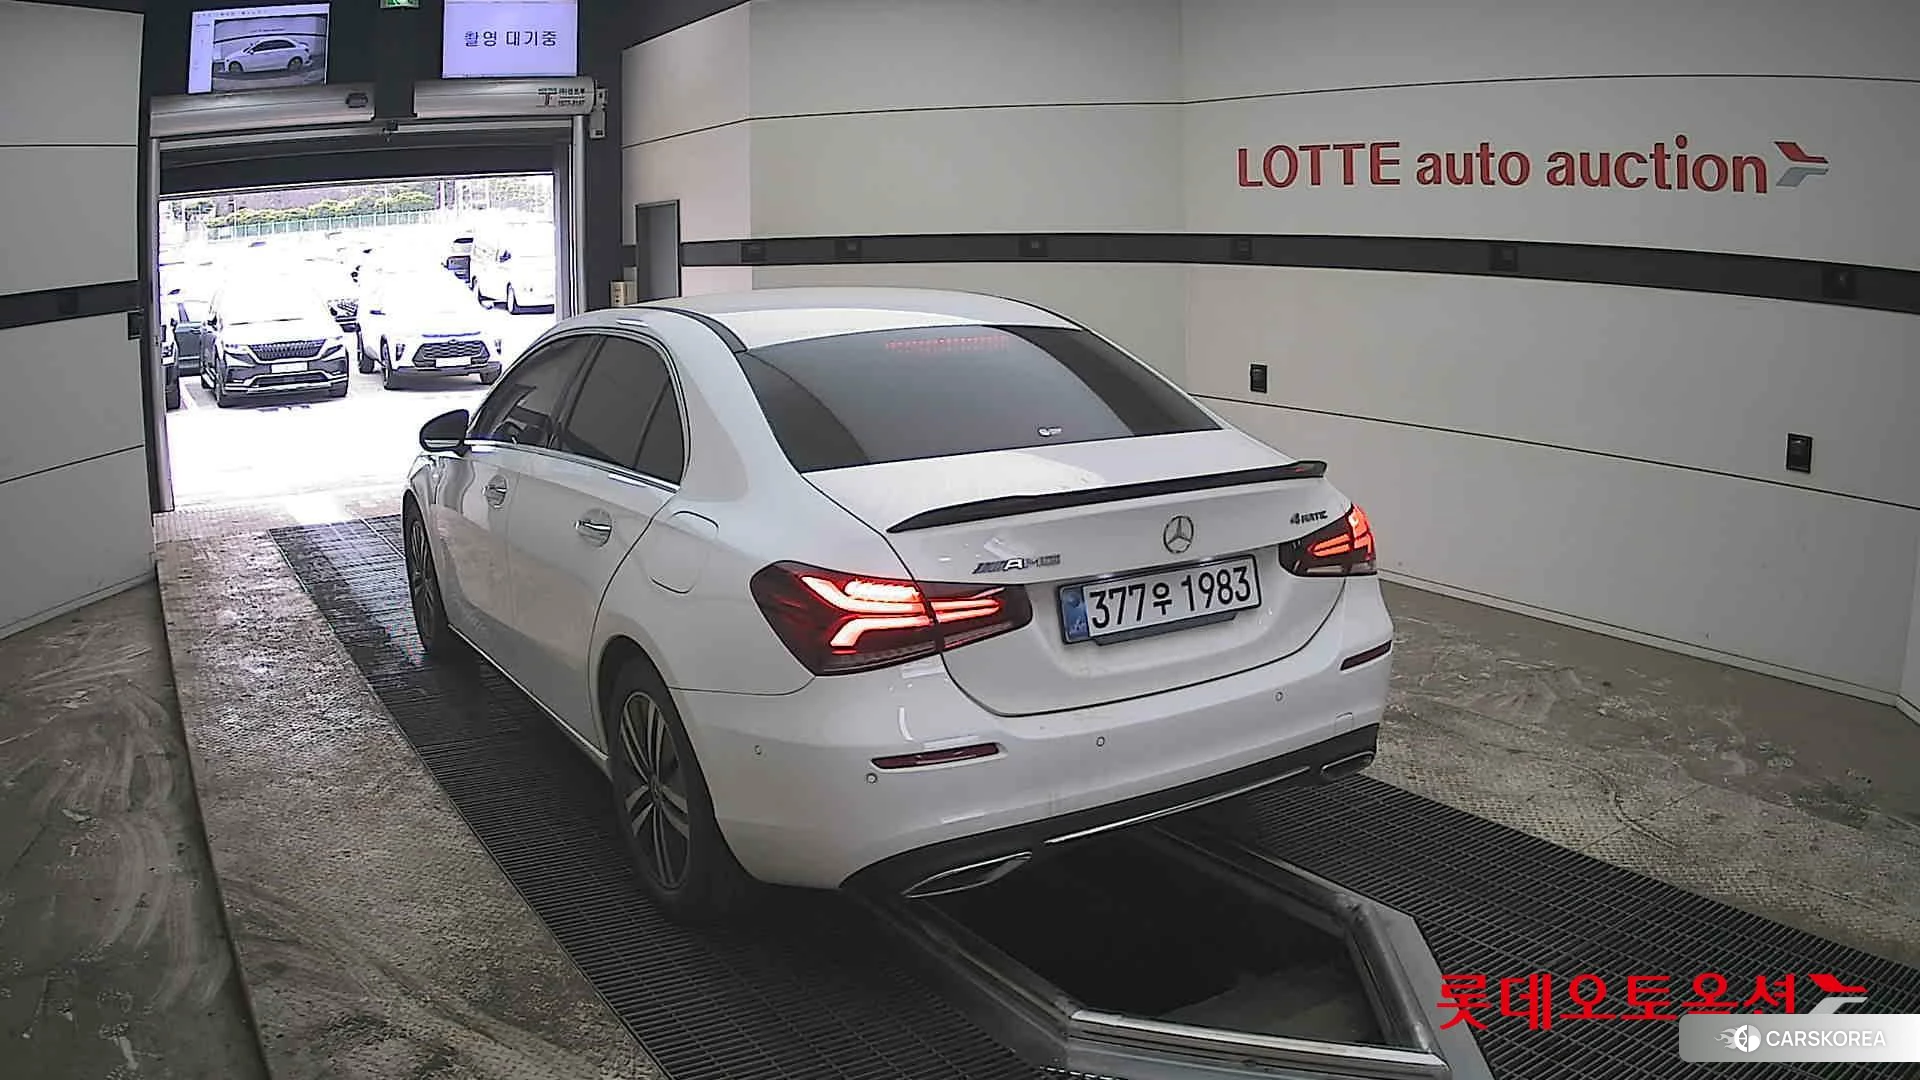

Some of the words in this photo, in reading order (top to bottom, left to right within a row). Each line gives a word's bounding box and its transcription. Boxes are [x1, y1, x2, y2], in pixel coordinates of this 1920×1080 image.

[506, 30, 557, 47] 대기중
[1238, 141, 1400, 188] LOTTE
[1416, 143, 1531, 187] auto
[1545, 135, 1767, 194] auction
[1089, 583, 1173, 628] 377우
[1181, 566, 1251, 611] 1983
